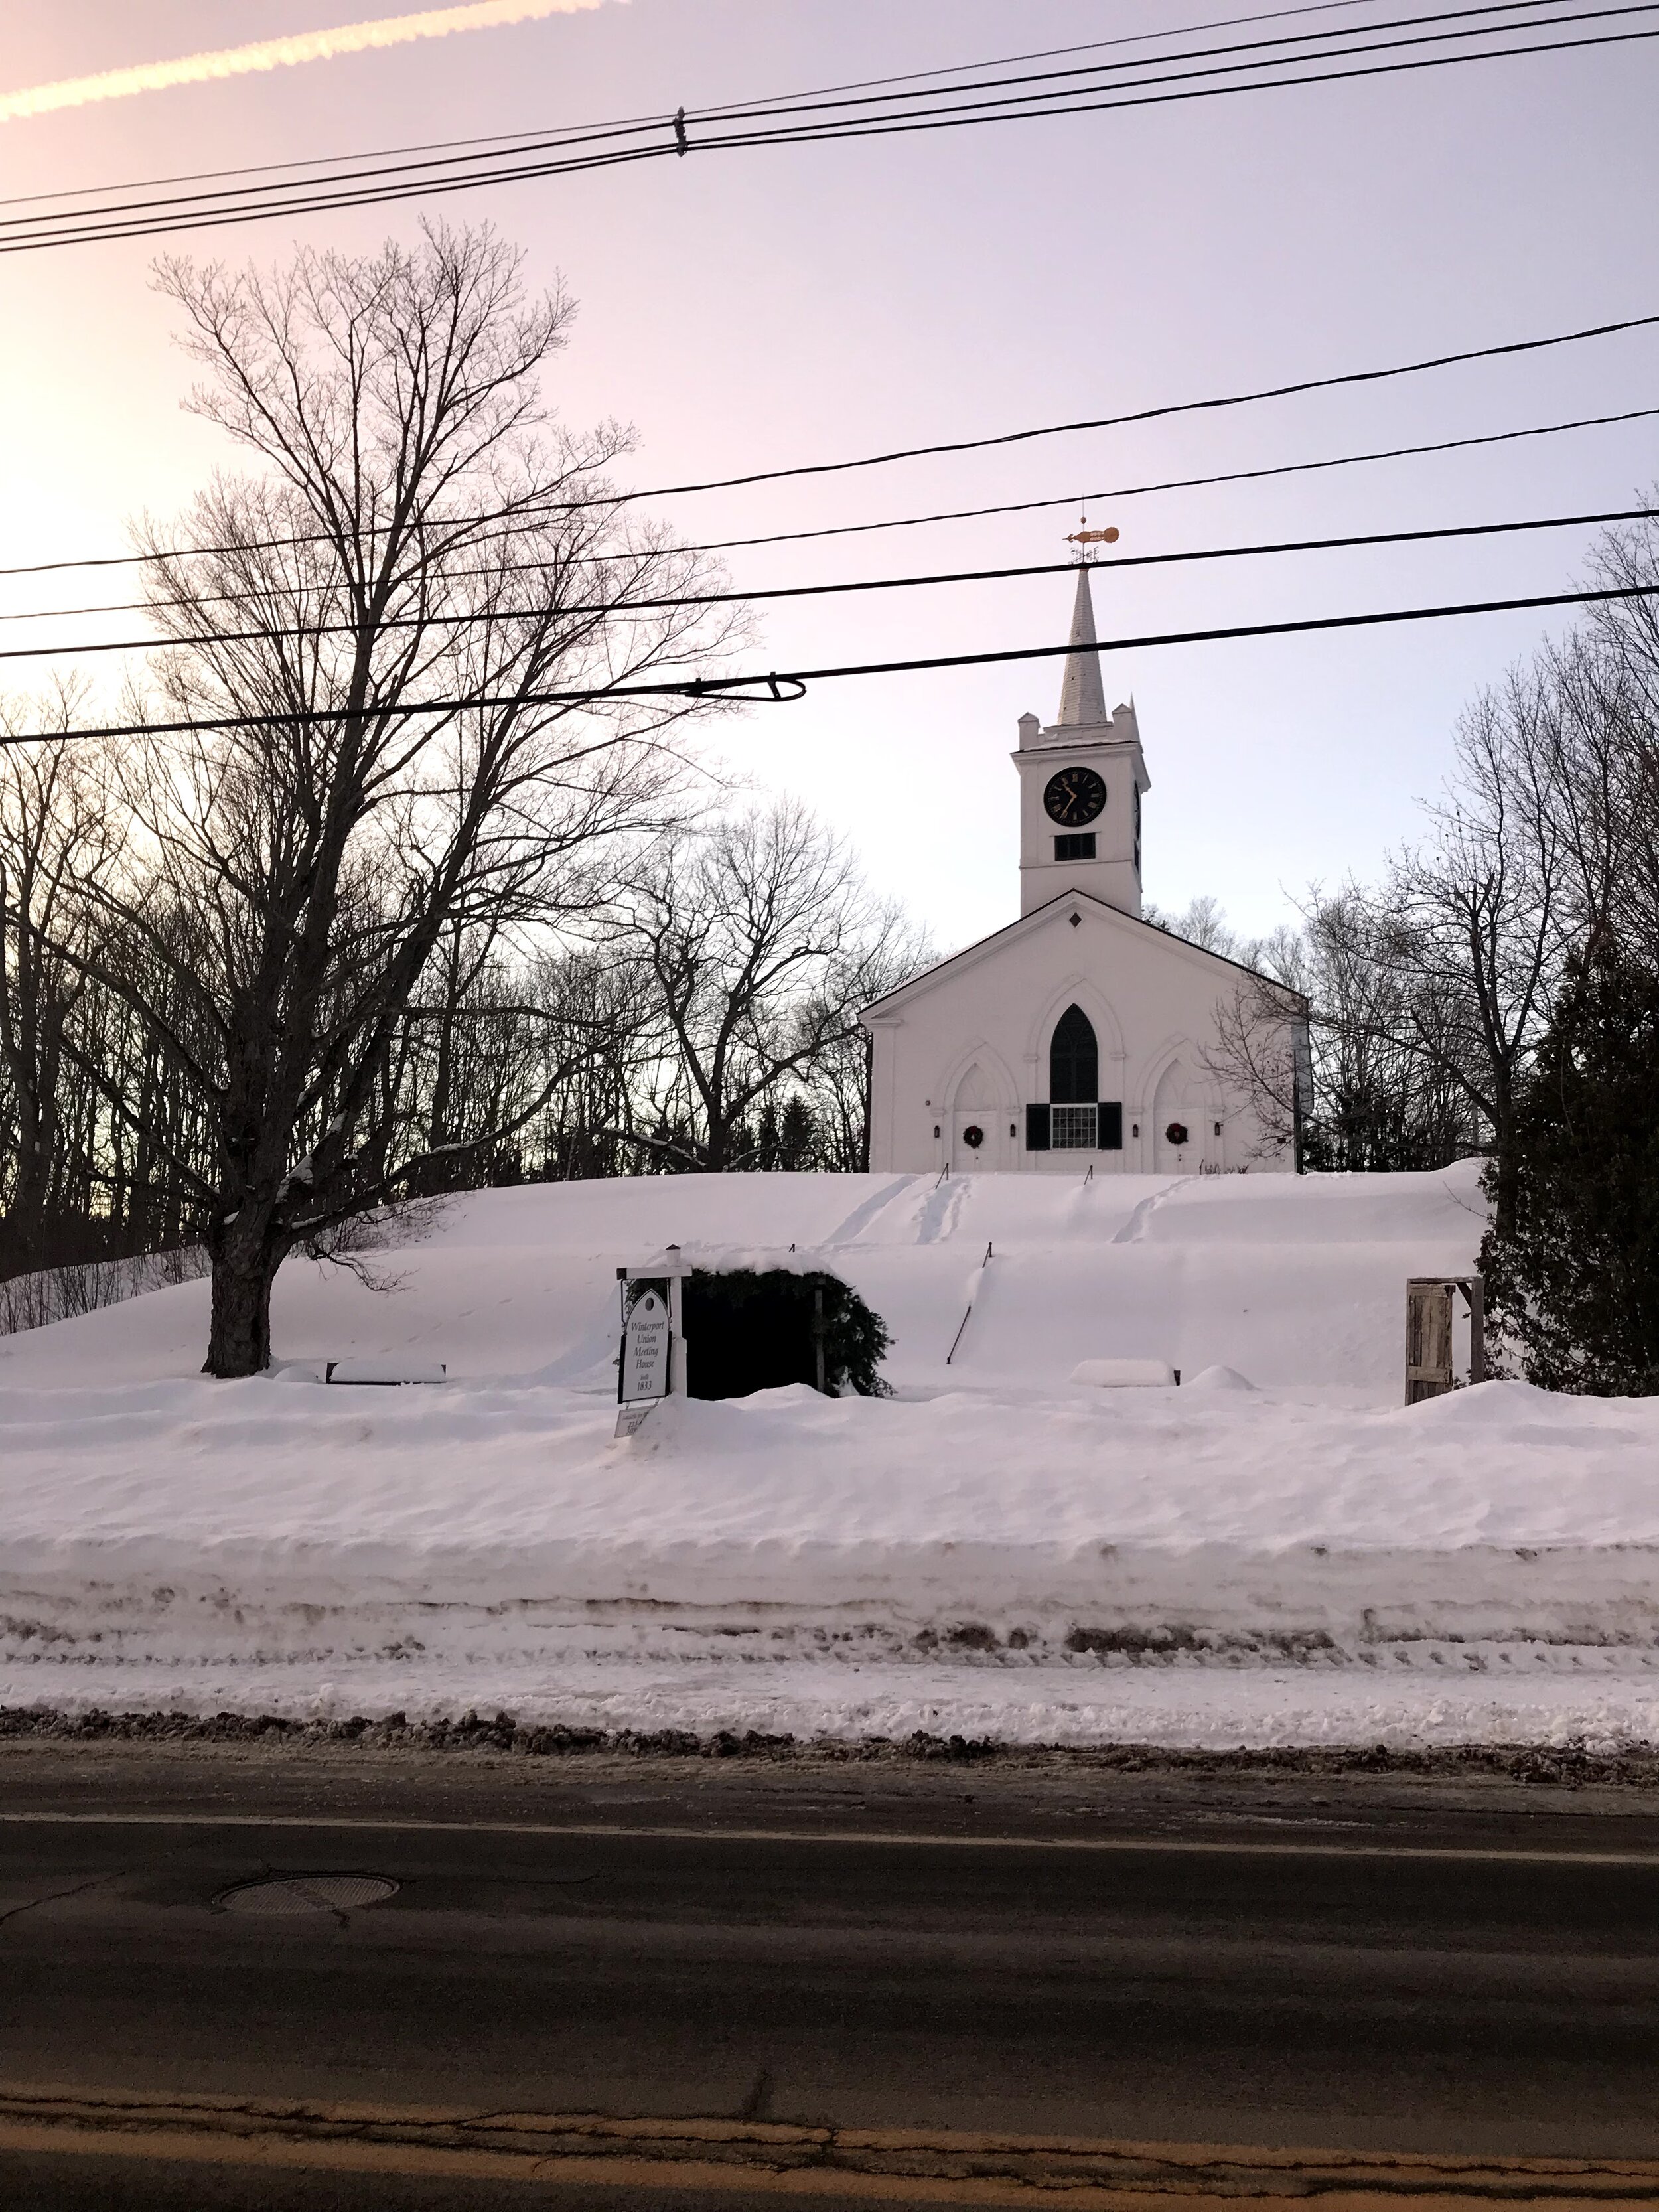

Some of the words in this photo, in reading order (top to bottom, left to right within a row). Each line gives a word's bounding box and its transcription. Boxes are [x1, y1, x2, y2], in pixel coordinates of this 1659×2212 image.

[631, 1322, 664, 1332] Winterport
[637, 1334, 656, 1343] Union
[633, 1347, 659, 1357] Meeting
[636, 1359, 654, 1369] House
[637, 1381, 652, 1391] 1833
